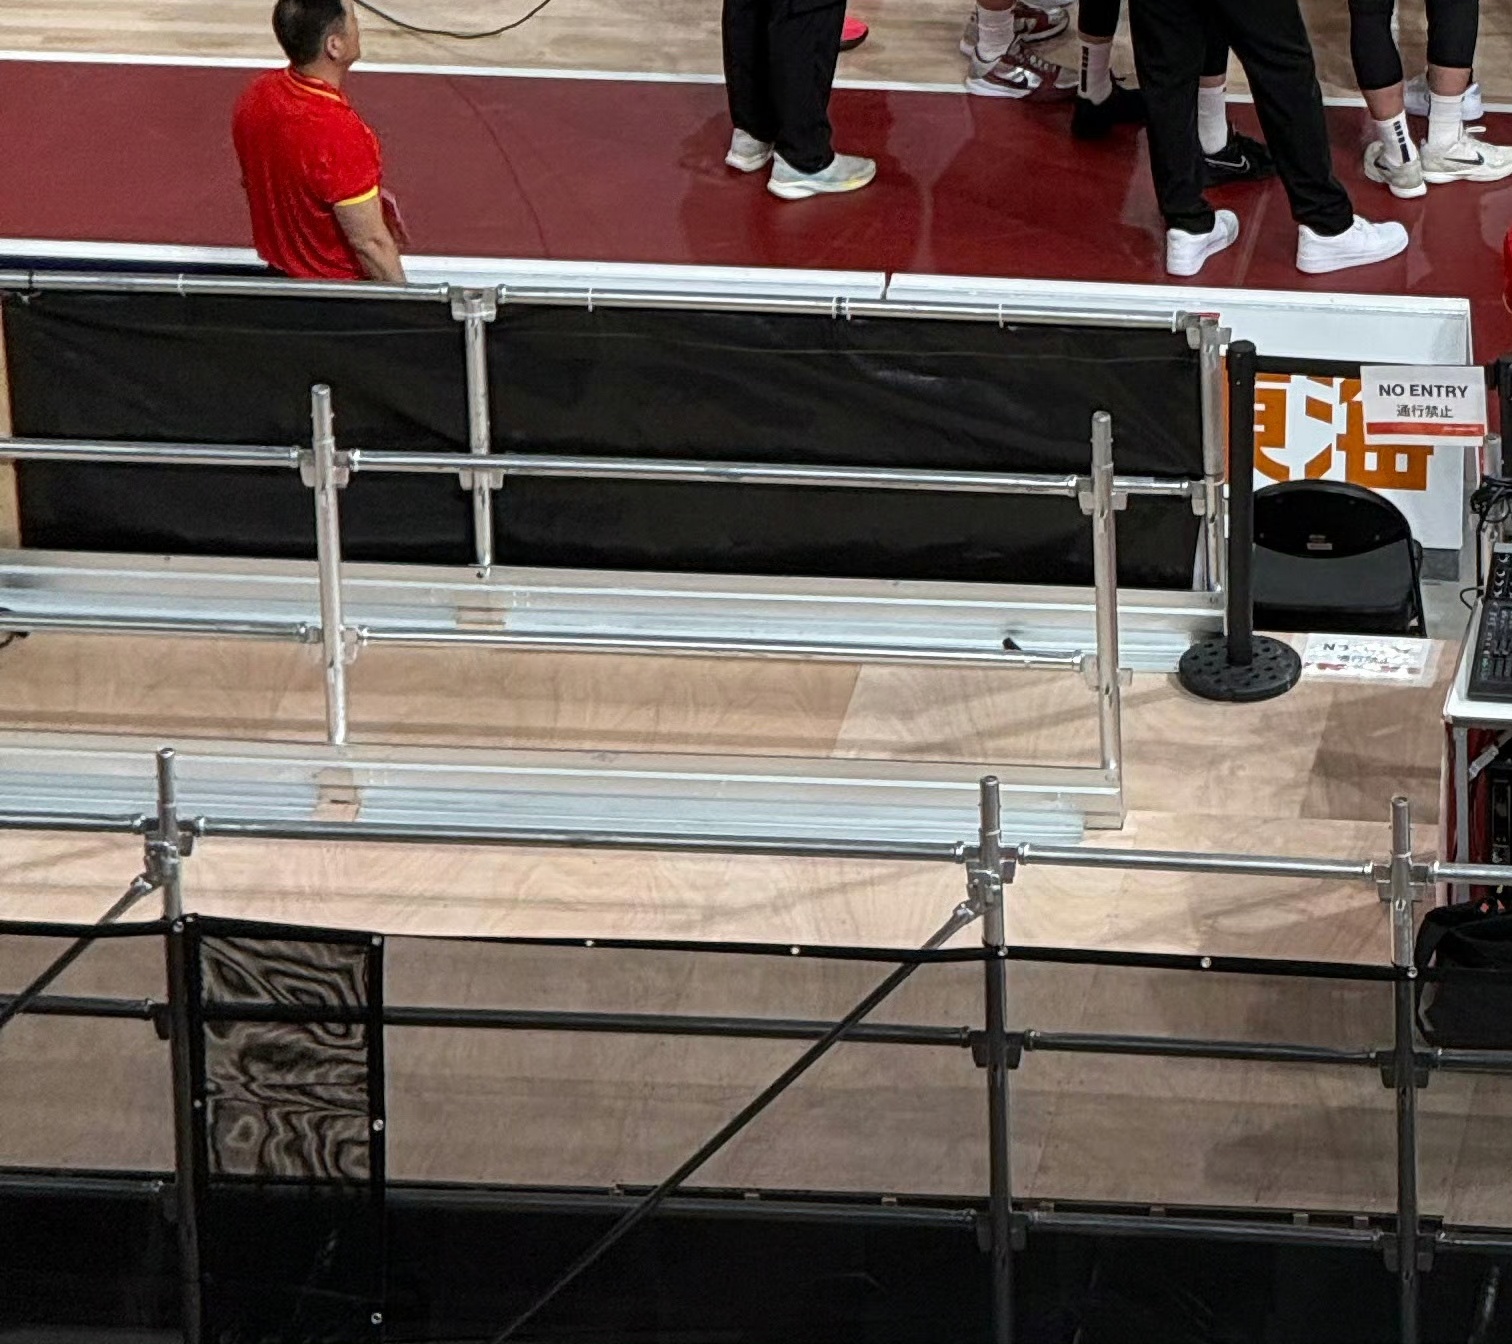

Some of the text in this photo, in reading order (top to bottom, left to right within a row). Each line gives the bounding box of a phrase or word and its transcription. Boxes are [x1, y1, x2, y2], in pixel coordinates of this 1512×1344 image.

[1379, 383, 1469, 398] NO ENTRY
[1396, 404, 1454, 418] 通行禁止
